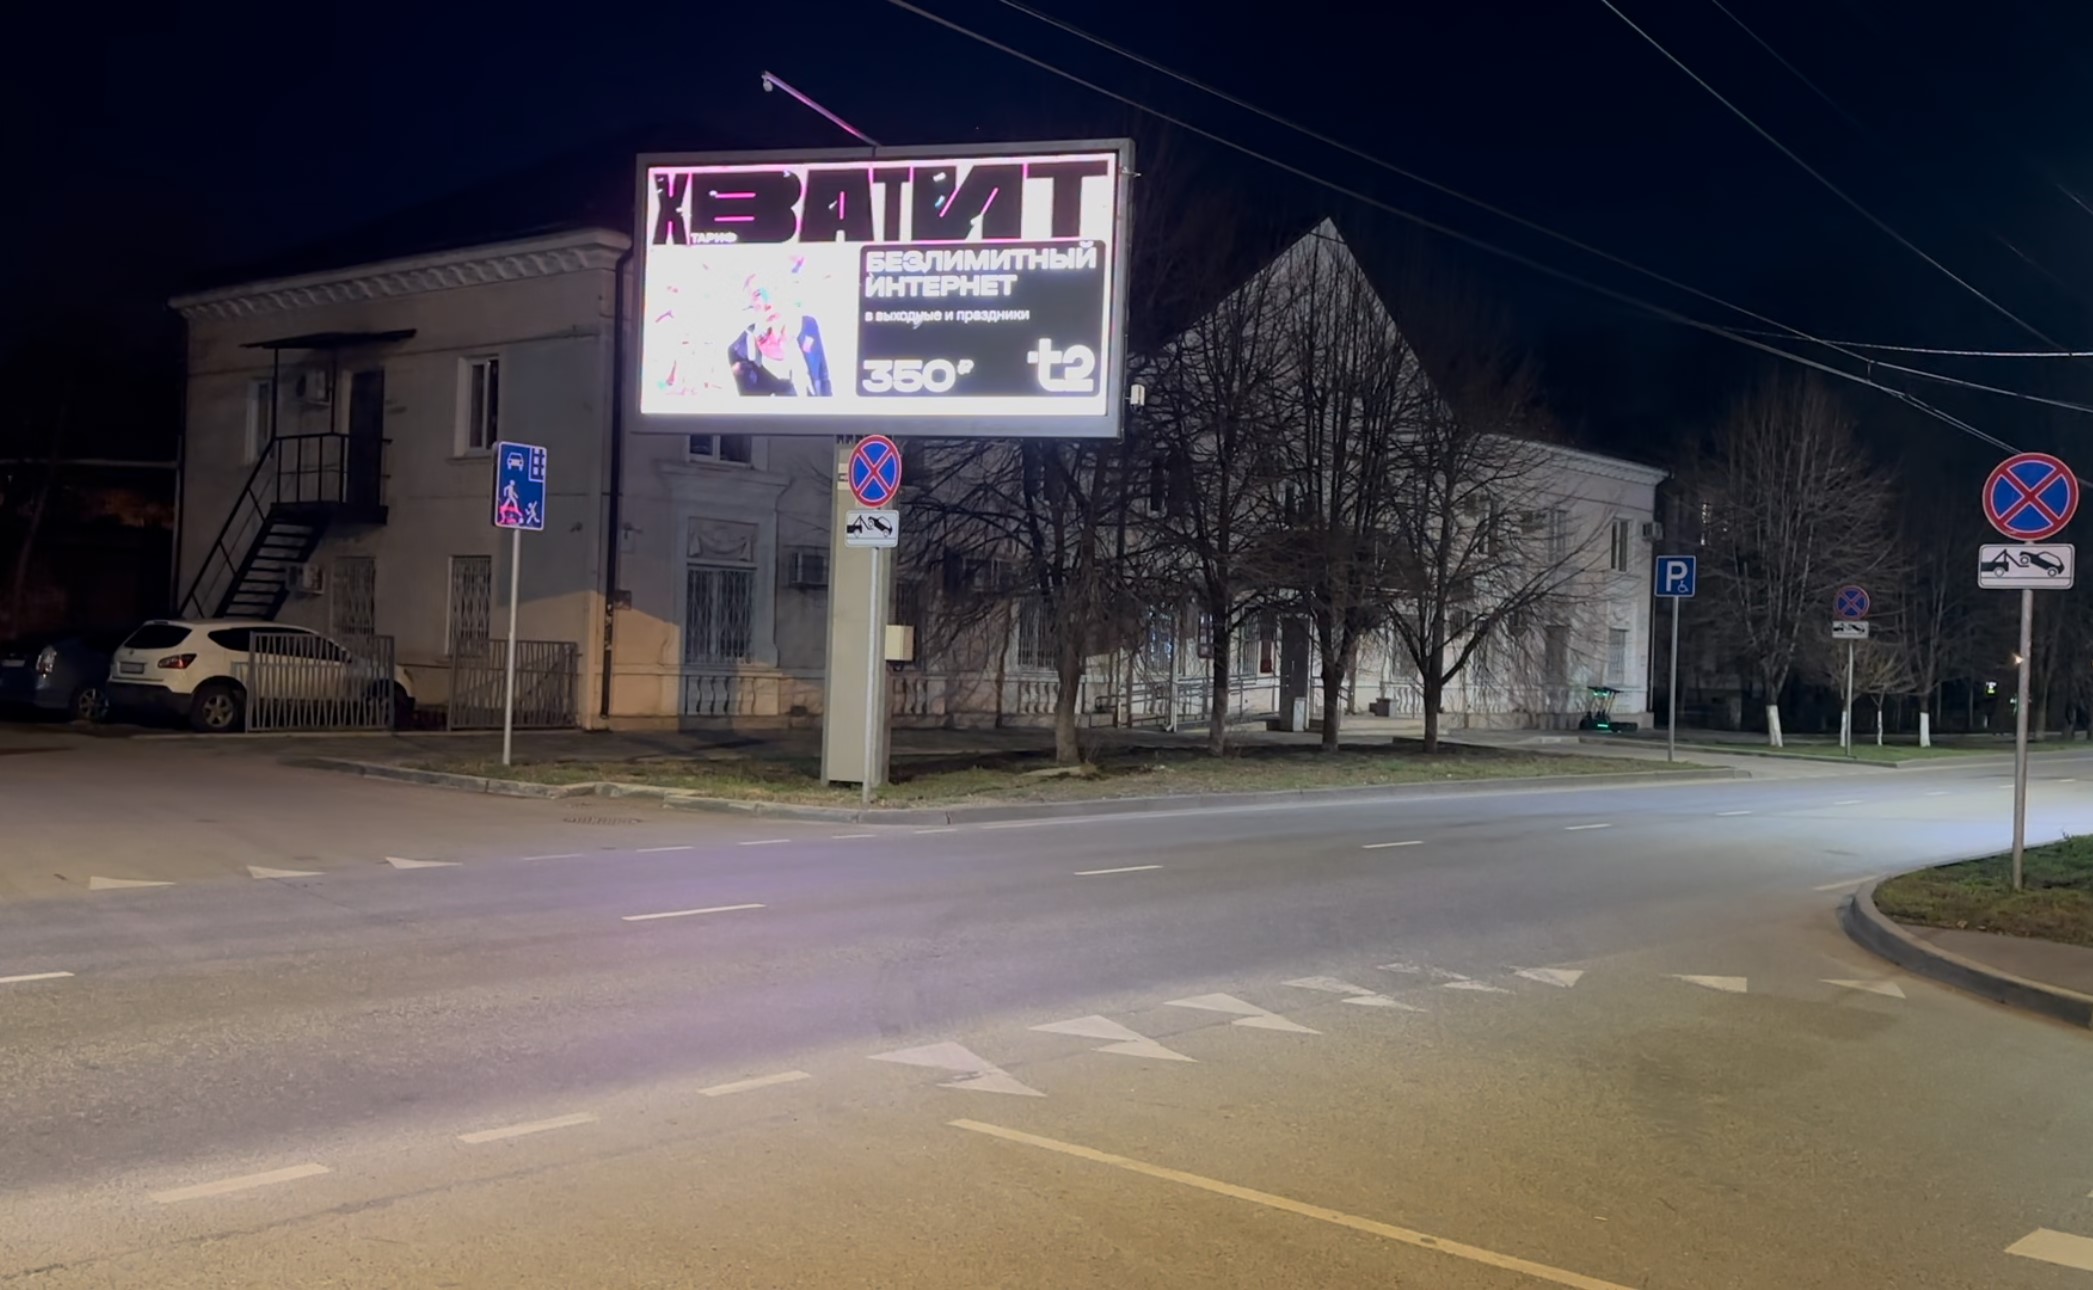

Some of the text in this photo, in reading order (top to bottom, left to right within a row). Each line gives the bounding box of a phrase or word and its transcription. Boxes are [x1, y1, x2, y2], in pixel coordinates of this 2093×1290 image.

[653, 160, 1108, 245] ХВАТИТ
[690, 232, 738, 244] ТАРИФ
[866, 240, 1097, 273] БЕЗЛИМИТНЫЙ
[865, 274, 1018, 298] ИНТЕРНЕТ
[865, 309, 1030, 324] в выходные и праздники
[1027, 338, 1096, 392] t2
[1666, 561, 1688, 592] P
